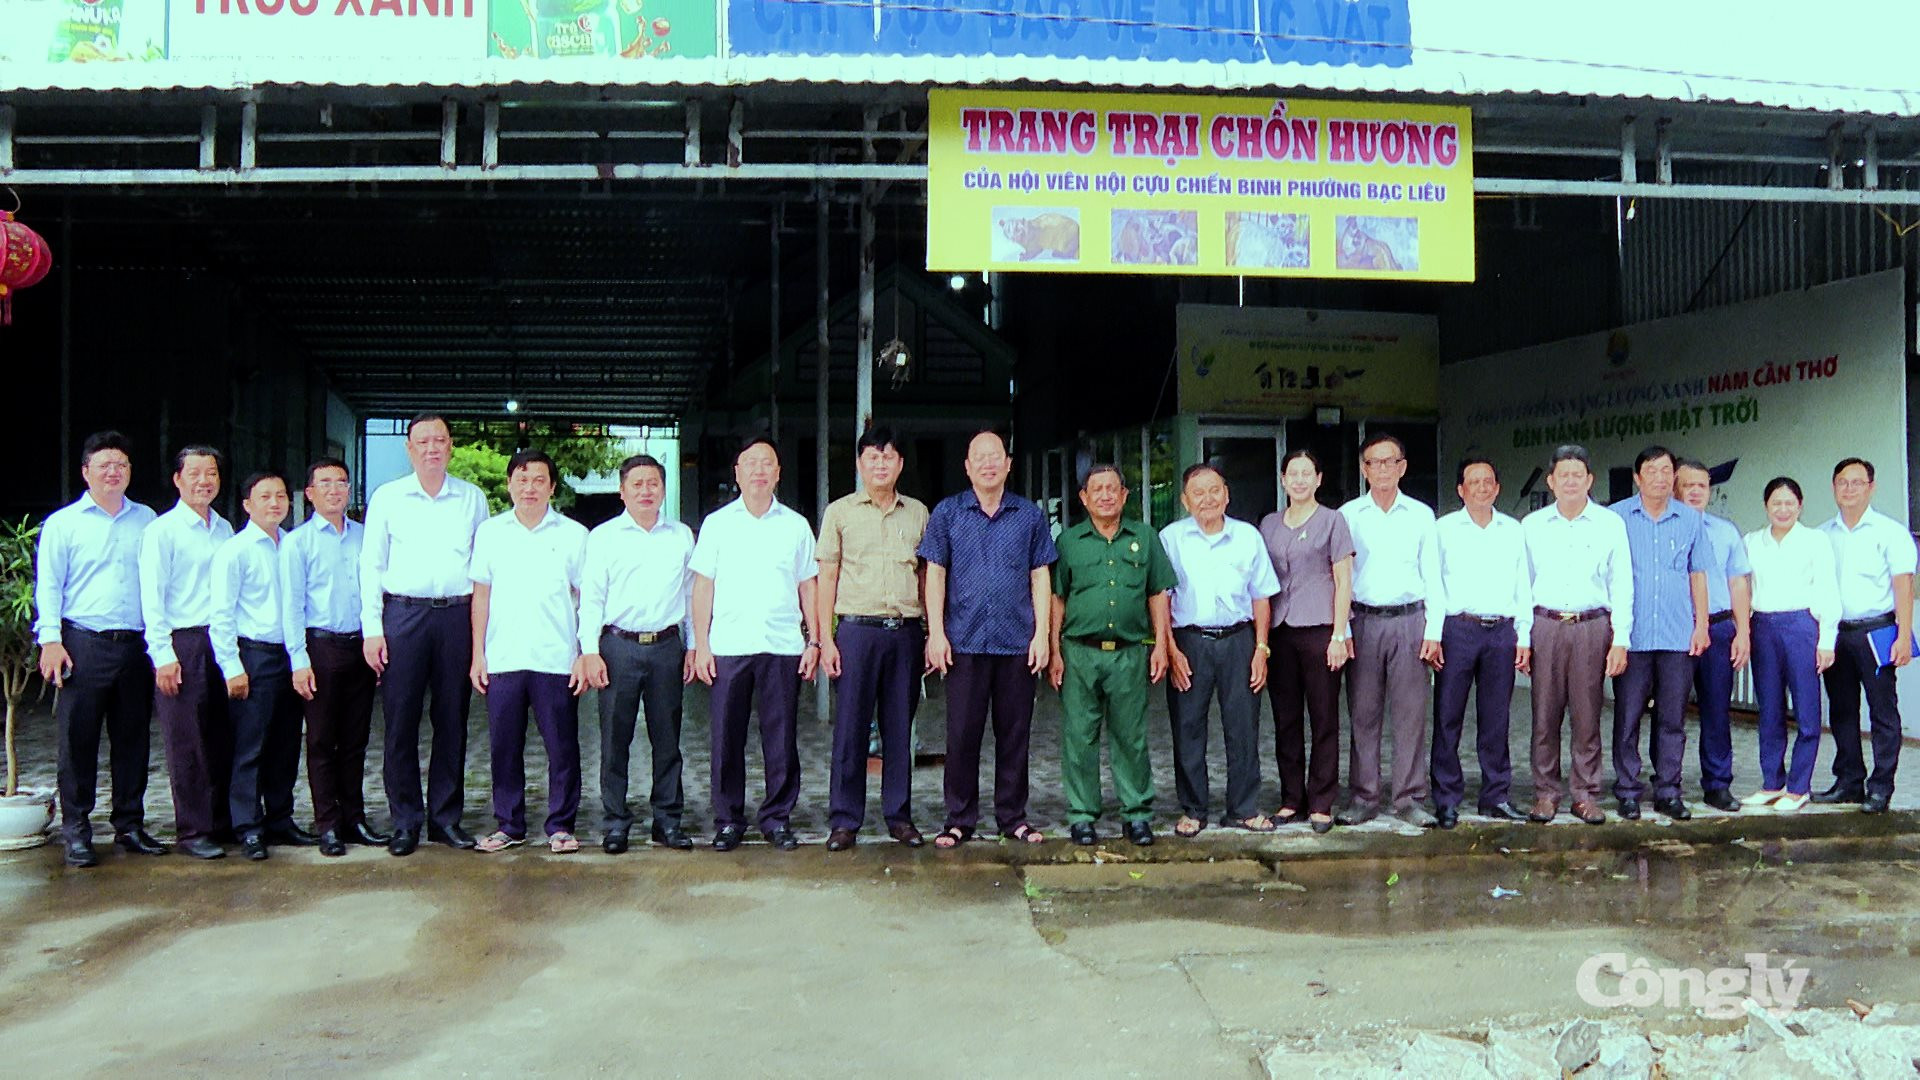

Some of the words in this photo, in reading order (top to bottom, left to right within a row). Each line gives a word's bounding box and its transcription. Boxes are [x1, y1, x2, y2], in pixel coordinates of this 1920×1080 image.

[962, 109, 1096, 154] TRANG
[1107, 112, 1200, 165] TRẠI
[1210, 100, 1318, 161] CHỒN
[1328, 120, 1458, 166] HƯƠNG
[963, 166, 1002, 190] CỦA
[1008, 170, 1040, 194] HỘI
[1045, 170, 1089, 192] VIÊN
[1095, 172, 1127, 196] HỘI
[1132, 174, 1170, 197] CỰU
[1176, 173, 1232, 195] CHIẾN
[1238, 178, 1281, 196] BINH
[1287, 178, 1362, 200] PHƯỜNG
[1367, 183, 1403, 204] BẠC
[1408, 182, 1447, 202] LIÊU
[1707, 371, 1749, 394] NAM
[1795, 353, 1841, 382] THƠ
[1593, 411, 1656, 442] LƯỢNG
[1660, 401, 1704, 437] MẶT
[1709, 395, 1759, 427] TRỜI
